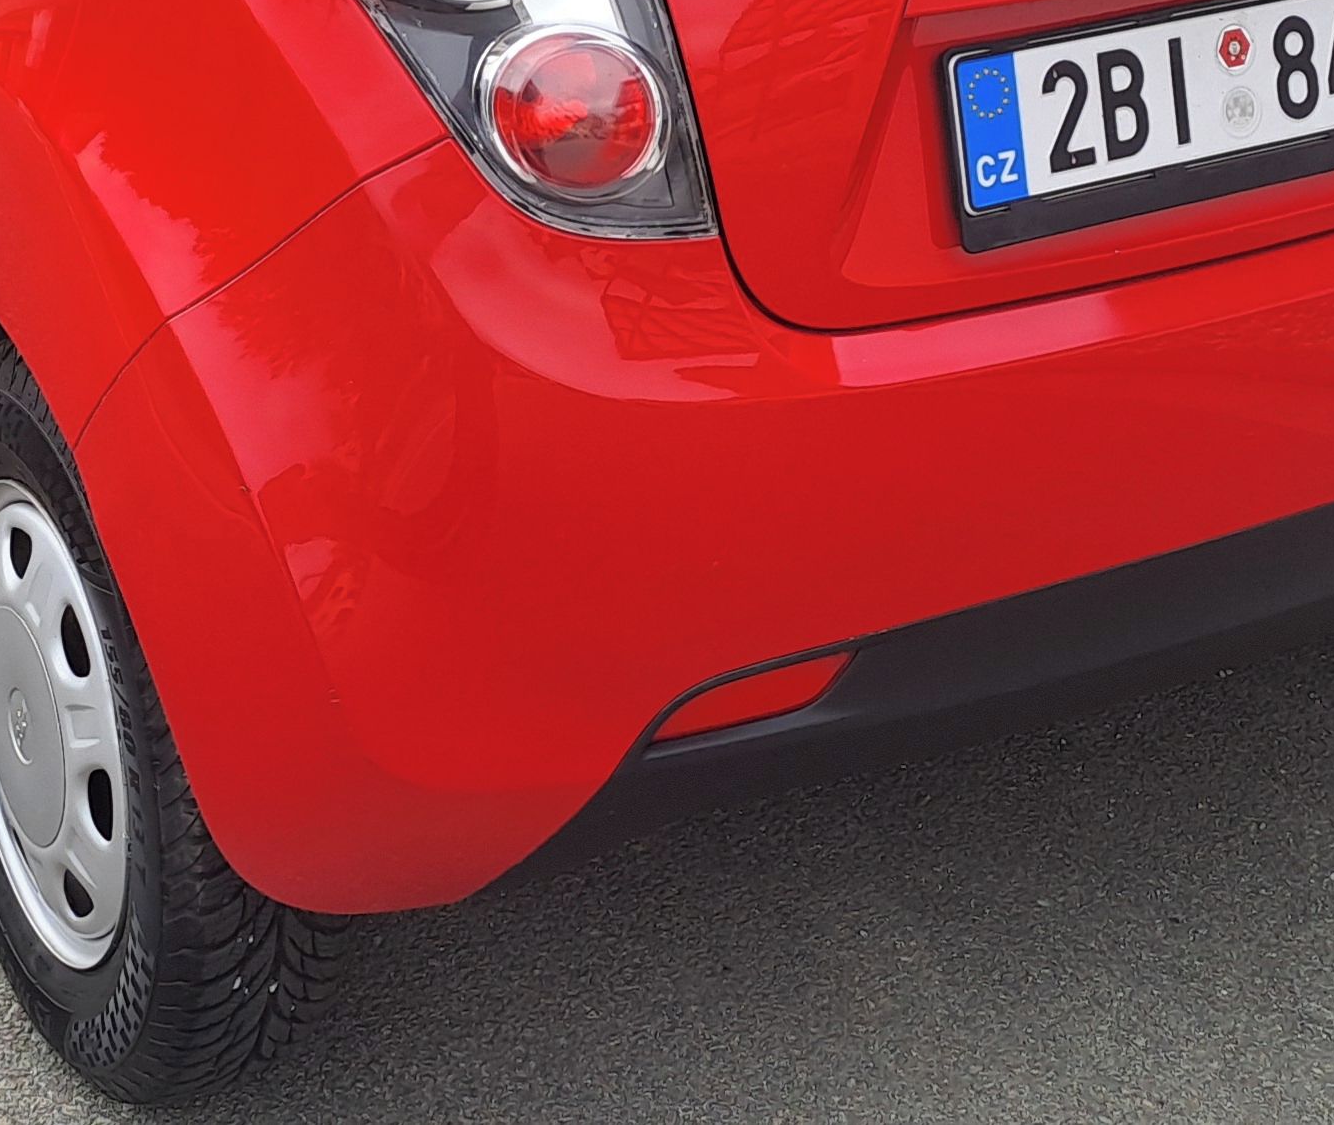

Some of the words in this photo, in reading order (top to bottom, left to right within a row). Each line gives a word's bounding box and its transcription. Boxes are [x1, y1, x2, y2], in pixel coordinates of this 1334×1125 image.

[976, 150, 1019, 188] CZ
[1042, 48, 1191, 173] 2BI
[100, 626, 137, 757] 155/80
